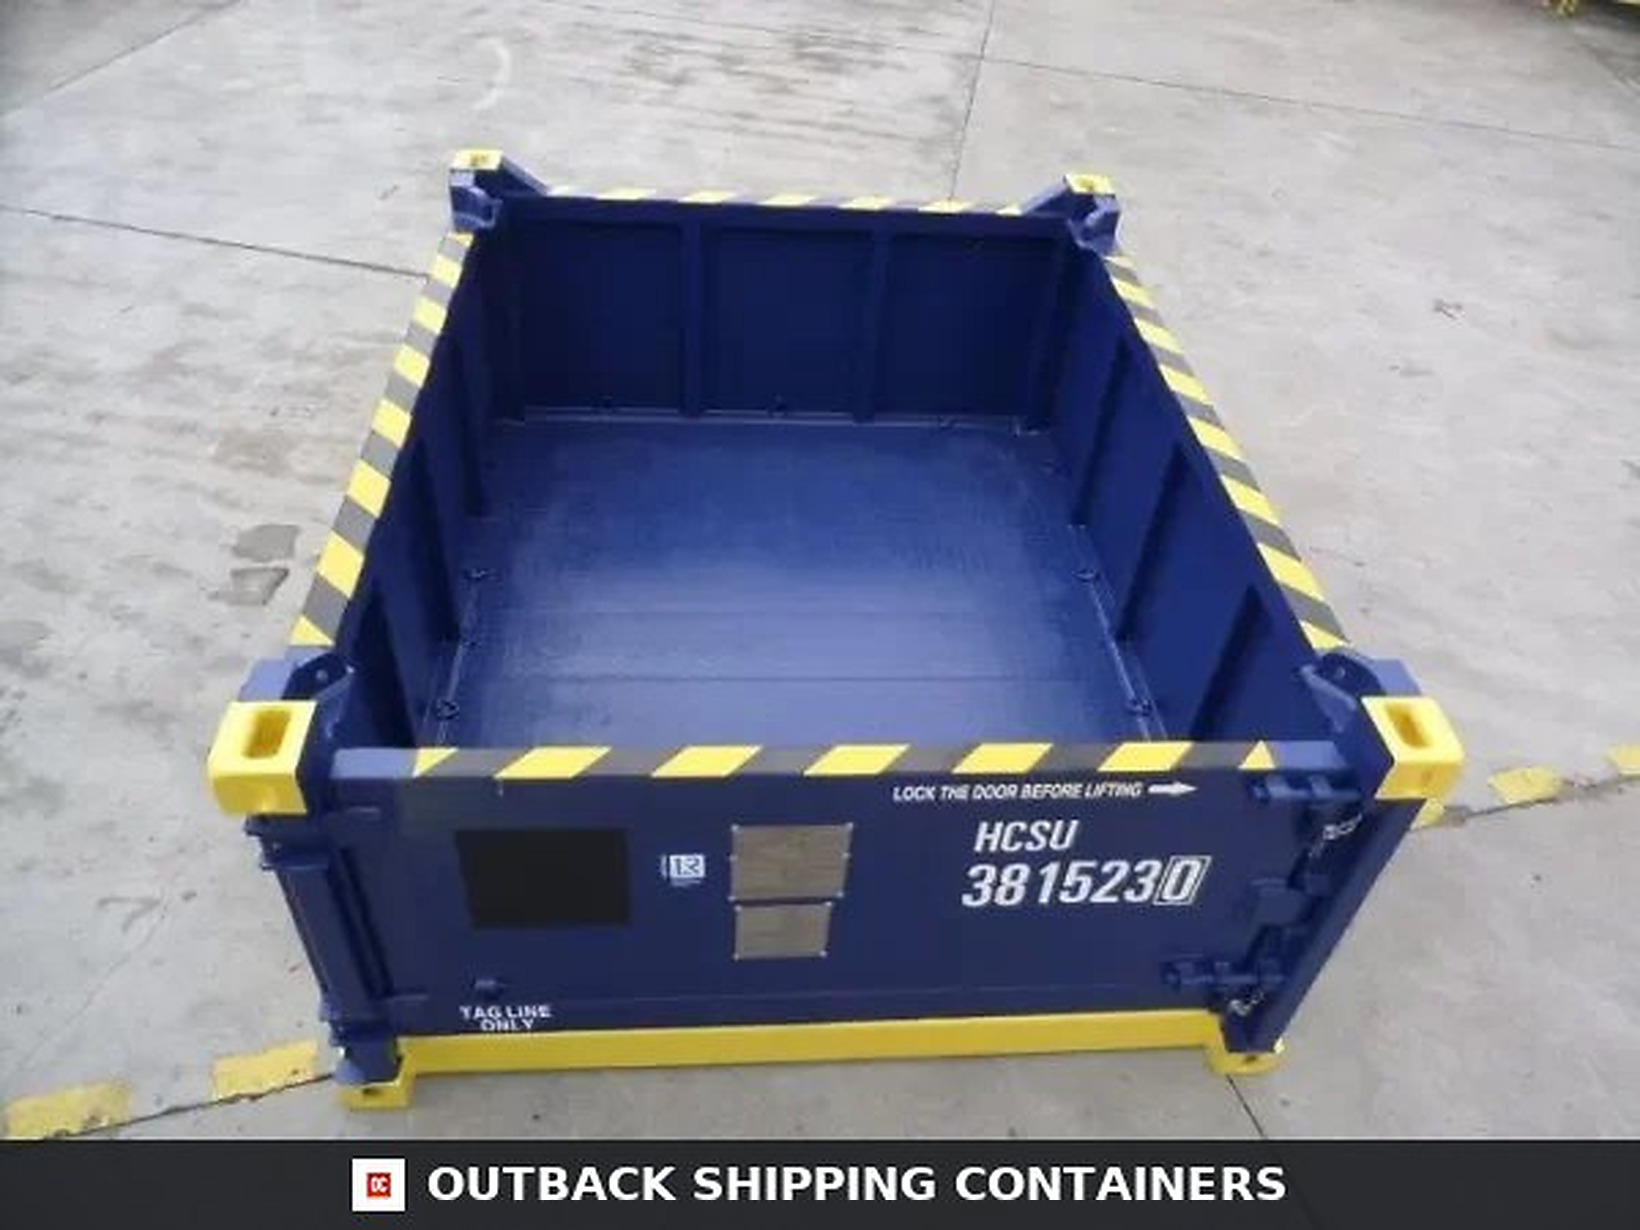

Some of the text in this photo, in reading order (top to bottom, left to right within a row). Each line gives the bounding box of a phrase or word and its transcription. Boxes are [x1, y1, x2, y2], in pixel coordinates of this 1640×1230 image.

[893, 780, 1142, 801] LOCK THE DOOR BEFORE LIFTING
[974, 819, 1079, 852] HCSU
[459, 1004, 552, 1020] TAG LINE
[480, 1018, 534, 1032] ONLY
